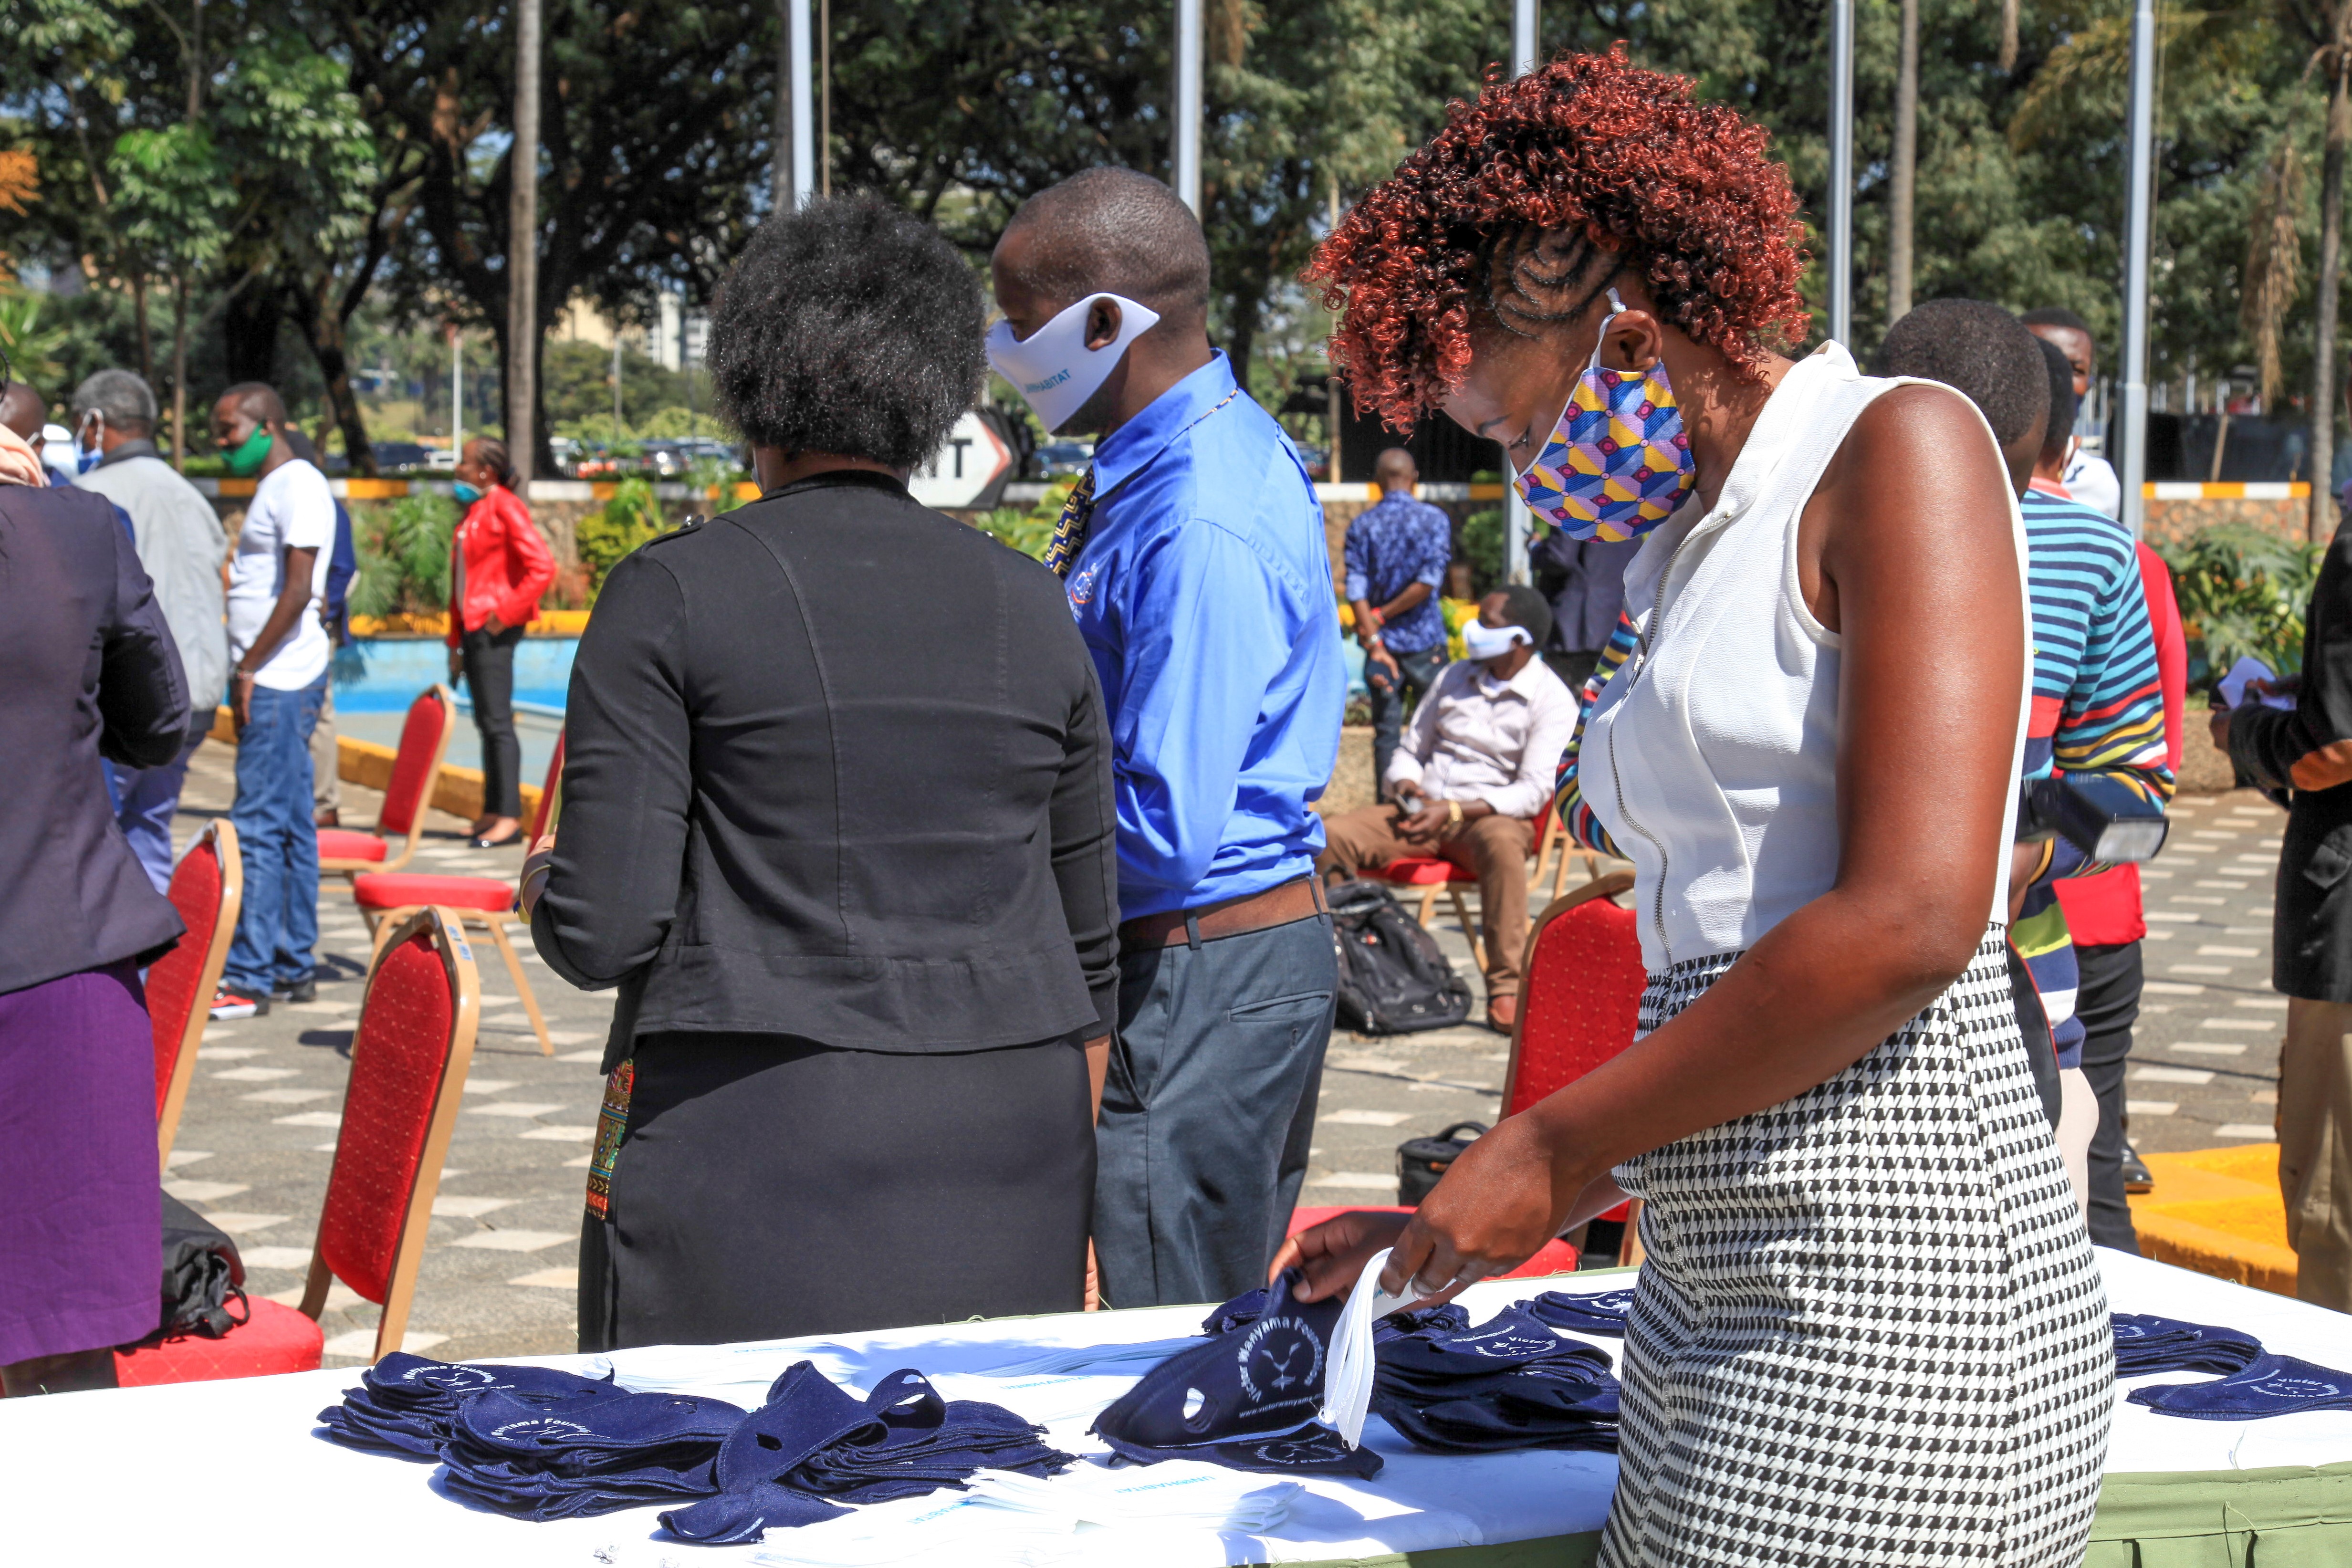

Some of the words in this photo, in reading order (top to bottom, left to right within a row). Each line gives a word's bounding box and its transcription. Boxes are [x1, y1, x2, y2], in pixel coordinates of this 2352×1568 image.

[1237, 1316, 1290, 1363] Wanyama
[1294, 1316, 1325, 1386] Foundation
[401, 1365, 448, 1380] Wanyama
[1240, 1365, 1263, 1403] Victor
[1239, 1392, 1325, 1418] www.victorwanyama.o
[491, 1419, 539, 1436] Wanyama
